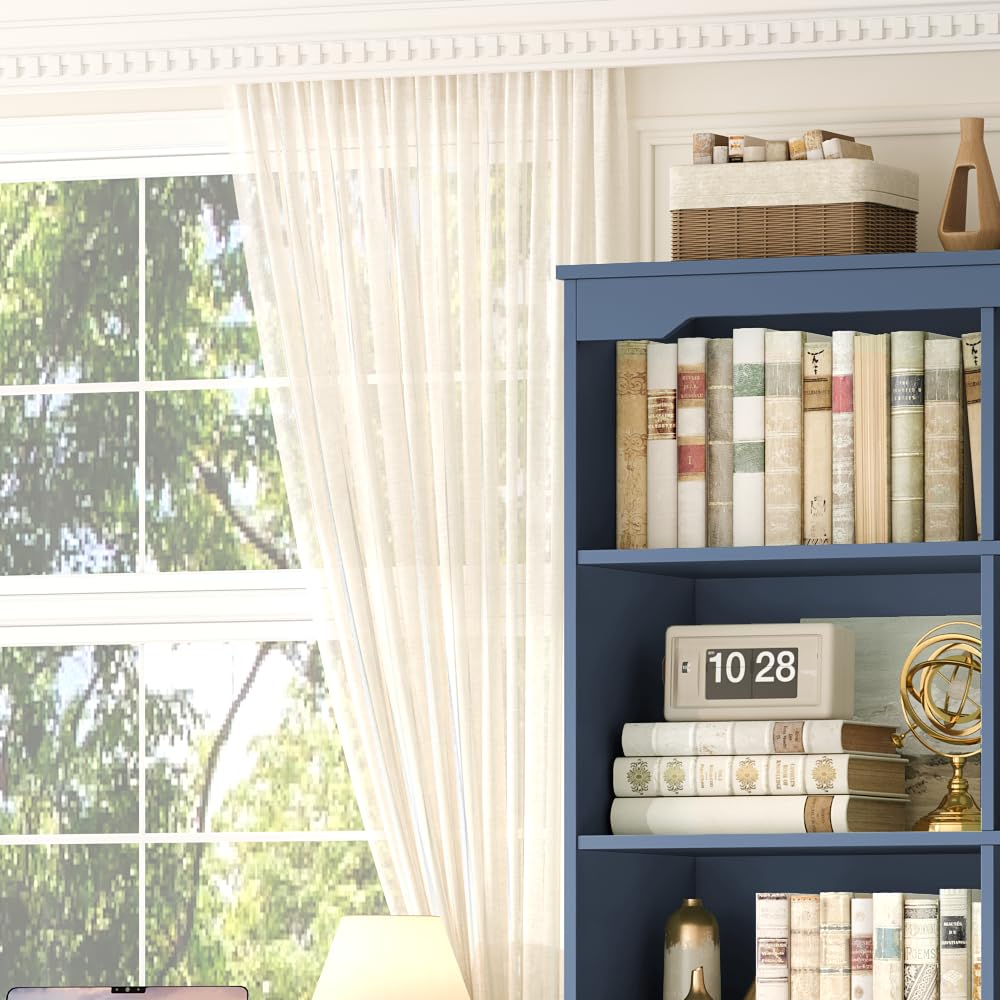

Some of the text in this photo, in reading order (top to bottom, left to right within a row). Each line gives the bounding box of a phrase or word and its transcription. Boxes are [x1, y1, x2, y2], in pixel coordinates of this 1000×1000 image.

[709, 650, 796, 683] 10 28
[905, 947, 937, 961] POEMS
